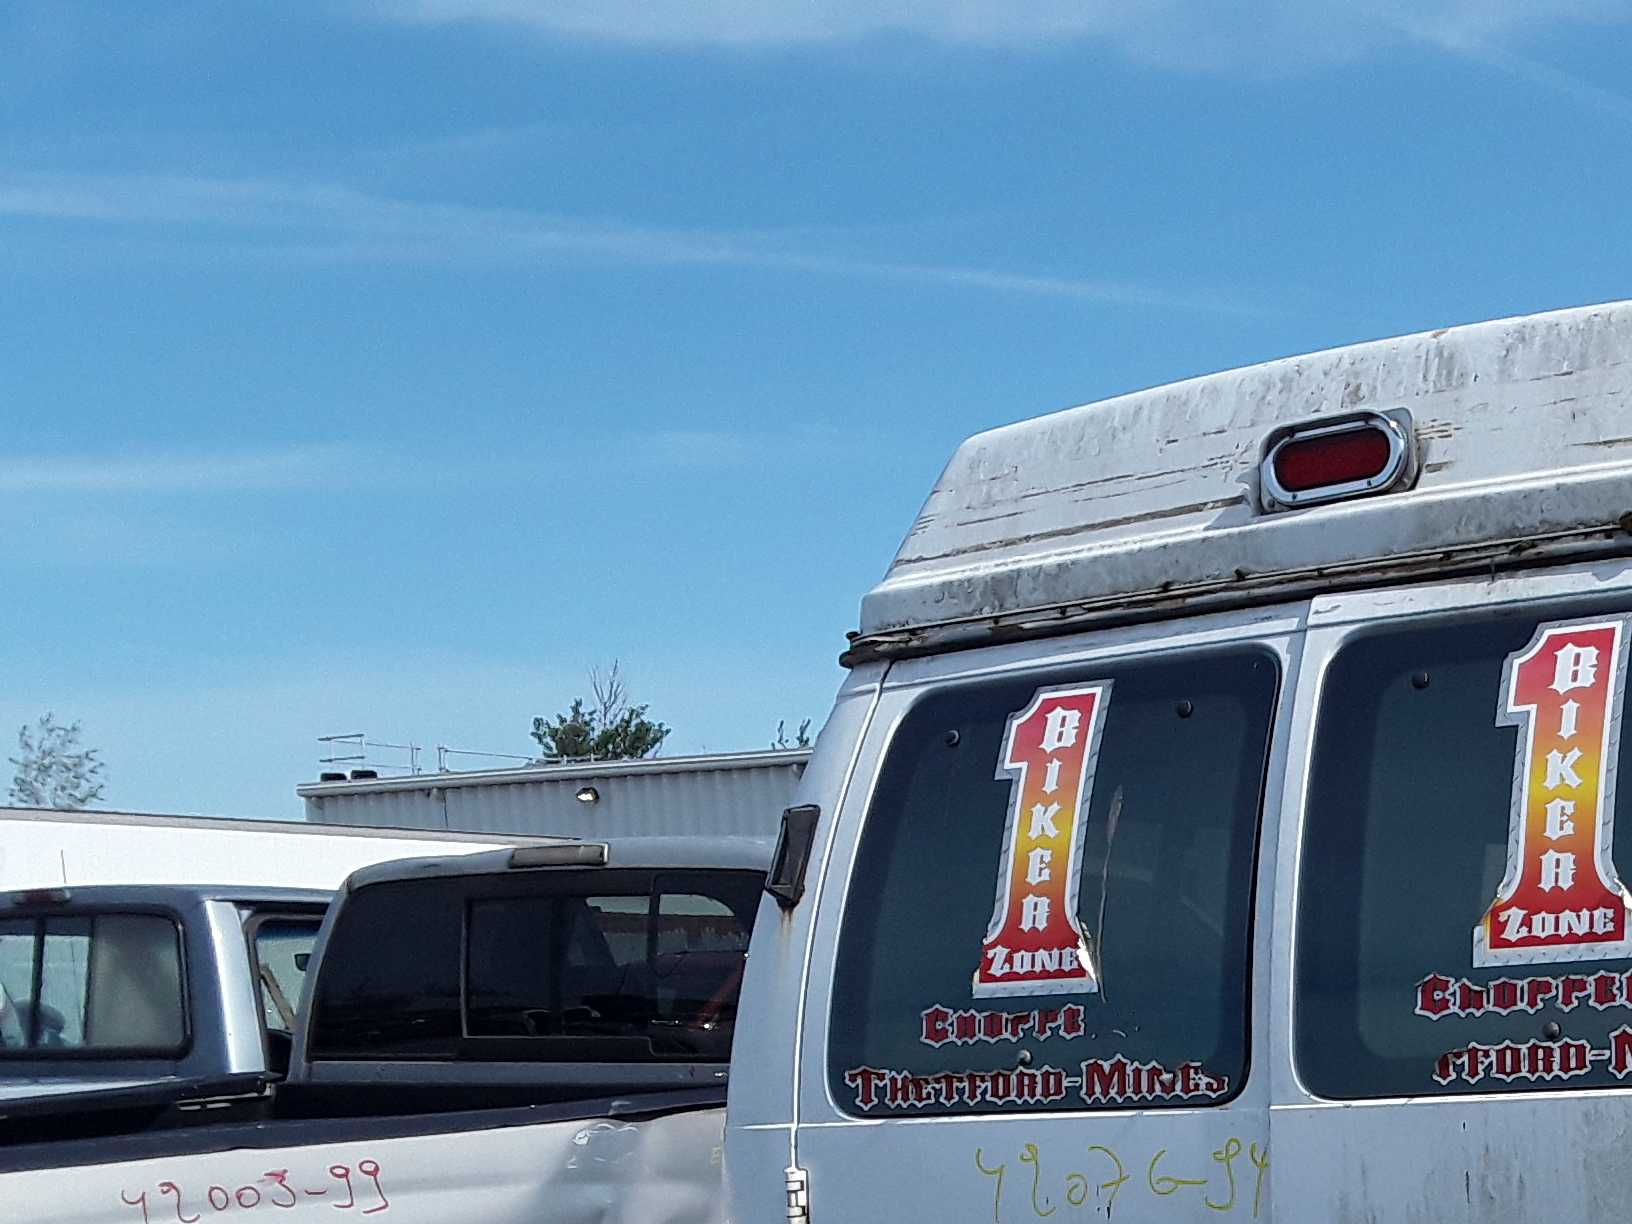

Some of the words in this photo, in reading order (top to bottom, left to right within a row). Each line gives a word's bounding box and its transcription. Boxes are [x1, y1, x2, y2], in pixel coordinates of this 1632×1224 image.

[1018, 706, 1083, 934] BIKER
[1536, 643, 1601, 893] BIKER
[986, 946, 1080, 977] ZONE
[1499, 906, 1616, 942] ZONE
